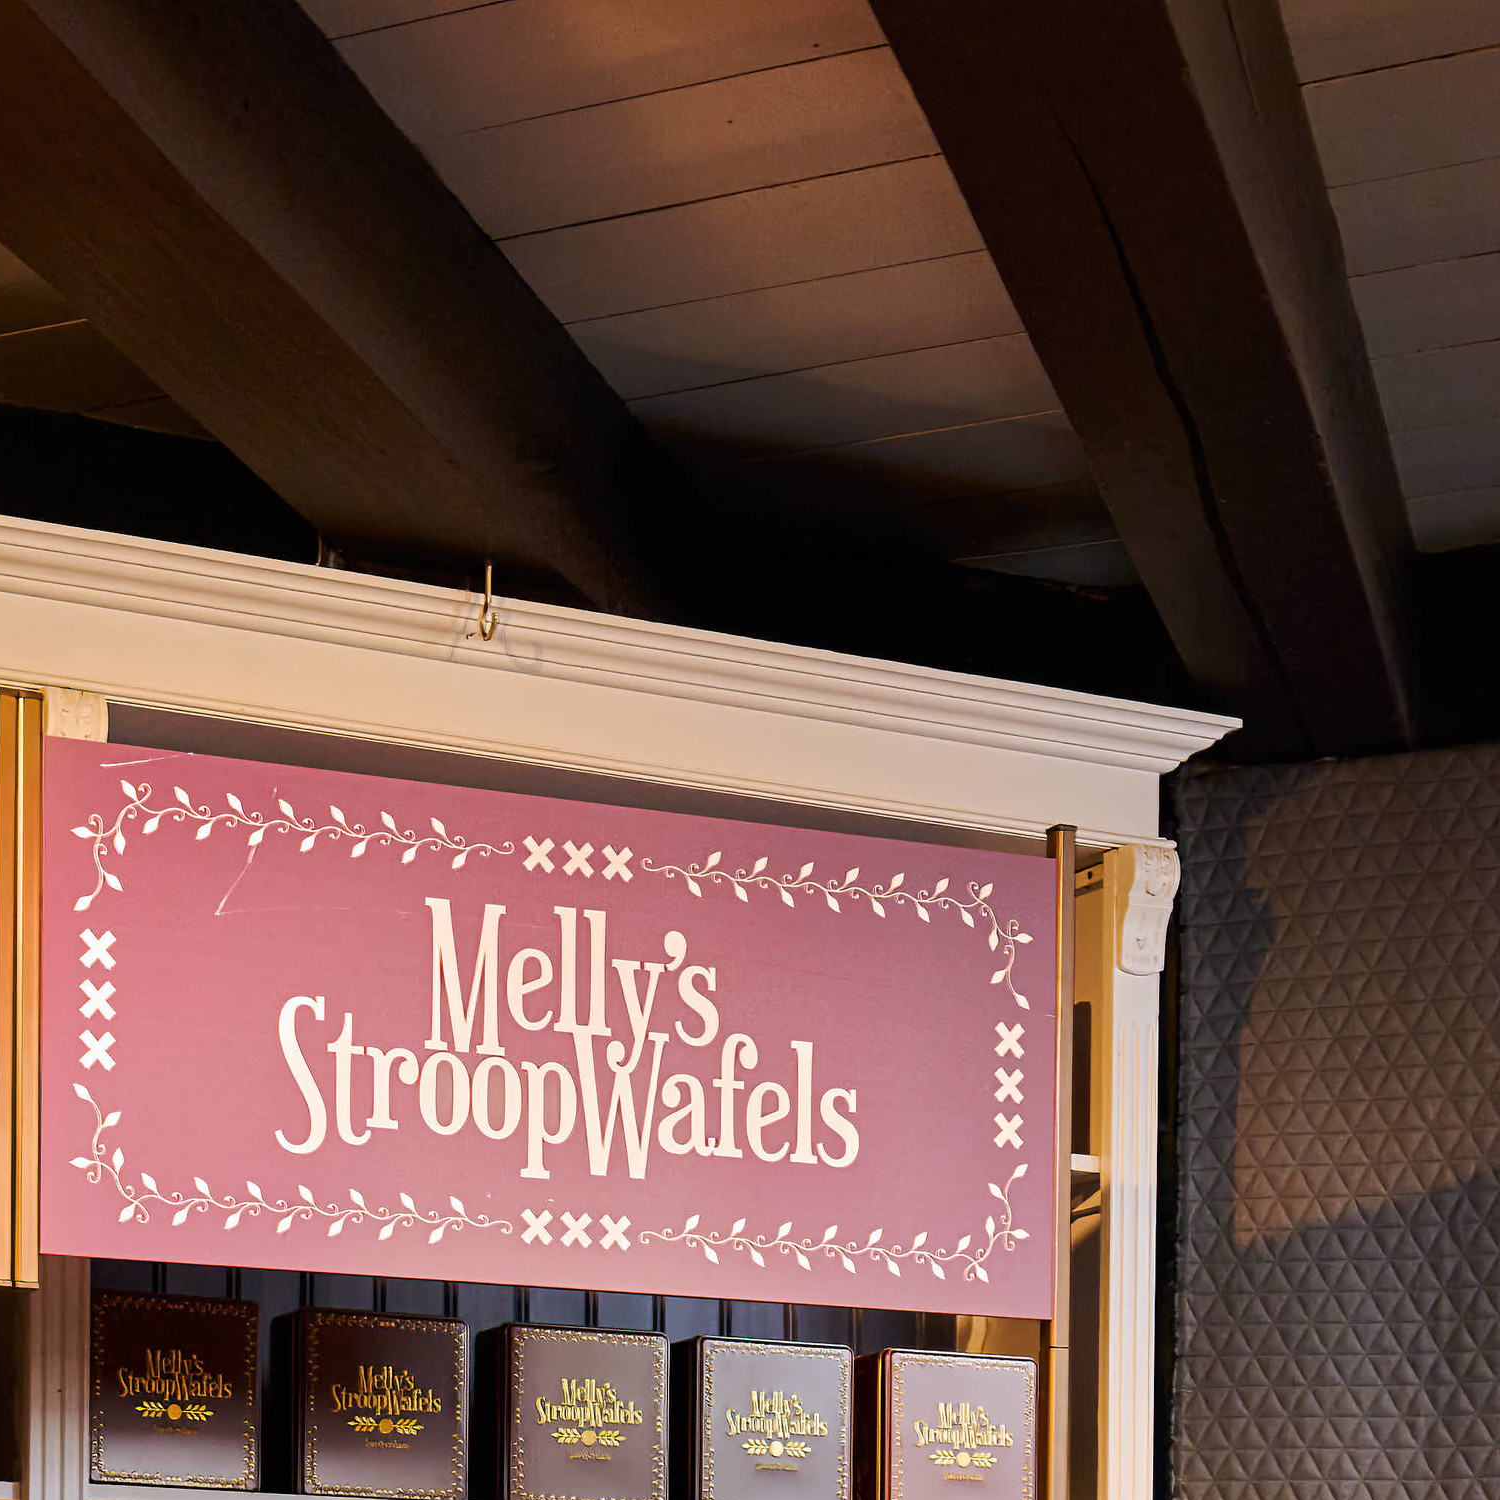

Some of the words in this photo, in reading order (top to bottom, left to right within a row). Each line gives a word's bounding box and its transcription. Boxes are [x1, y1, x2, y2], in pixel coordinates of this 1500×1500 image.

[424, 898, 720, 1067] Melly's
[275, 995, 859, 1179] StroopWafels
[146, 1348, 204, 1380] Melly's
[358, 1365, 414, 1394] Melly's
[117, 1367, 233, 1402] StroopWafels
[332, 1384, 441, 1416] StroopWafels
[562, 1378, 617, 1405] Melly's
